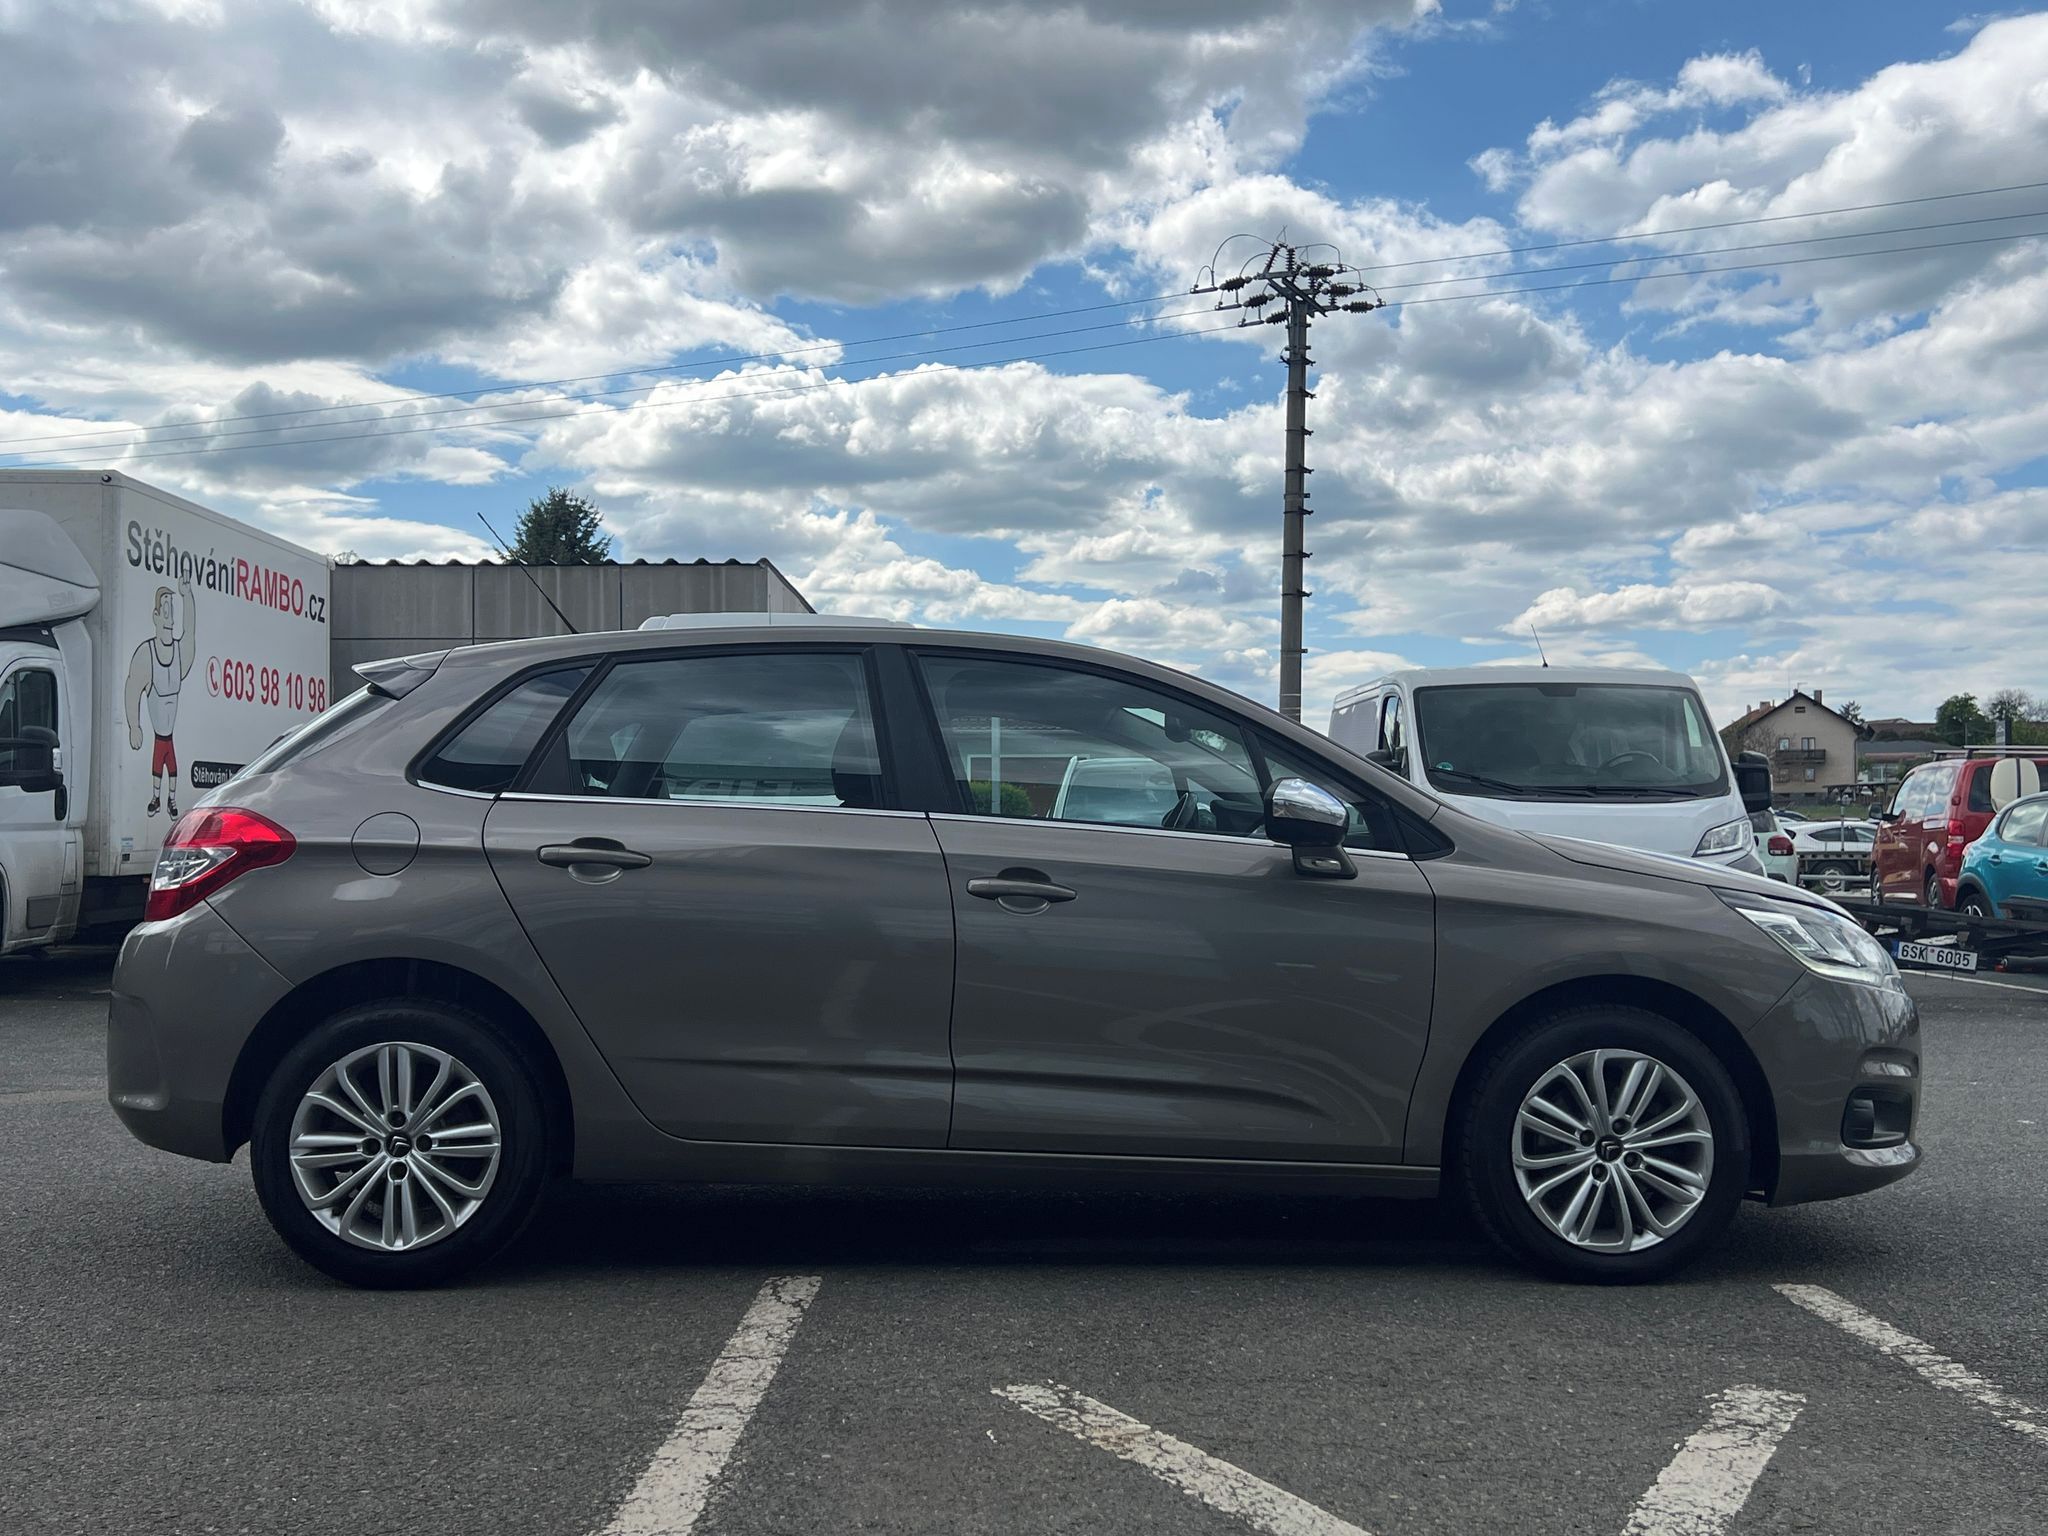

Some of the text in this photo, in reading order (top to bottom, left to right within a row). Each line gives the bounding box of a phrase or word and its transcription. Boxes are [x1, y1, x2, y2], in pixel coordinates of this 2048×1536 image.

[223, 659, 326, 713] 603 98 10 98
[1901, 945, 1927, 960] 6SK
